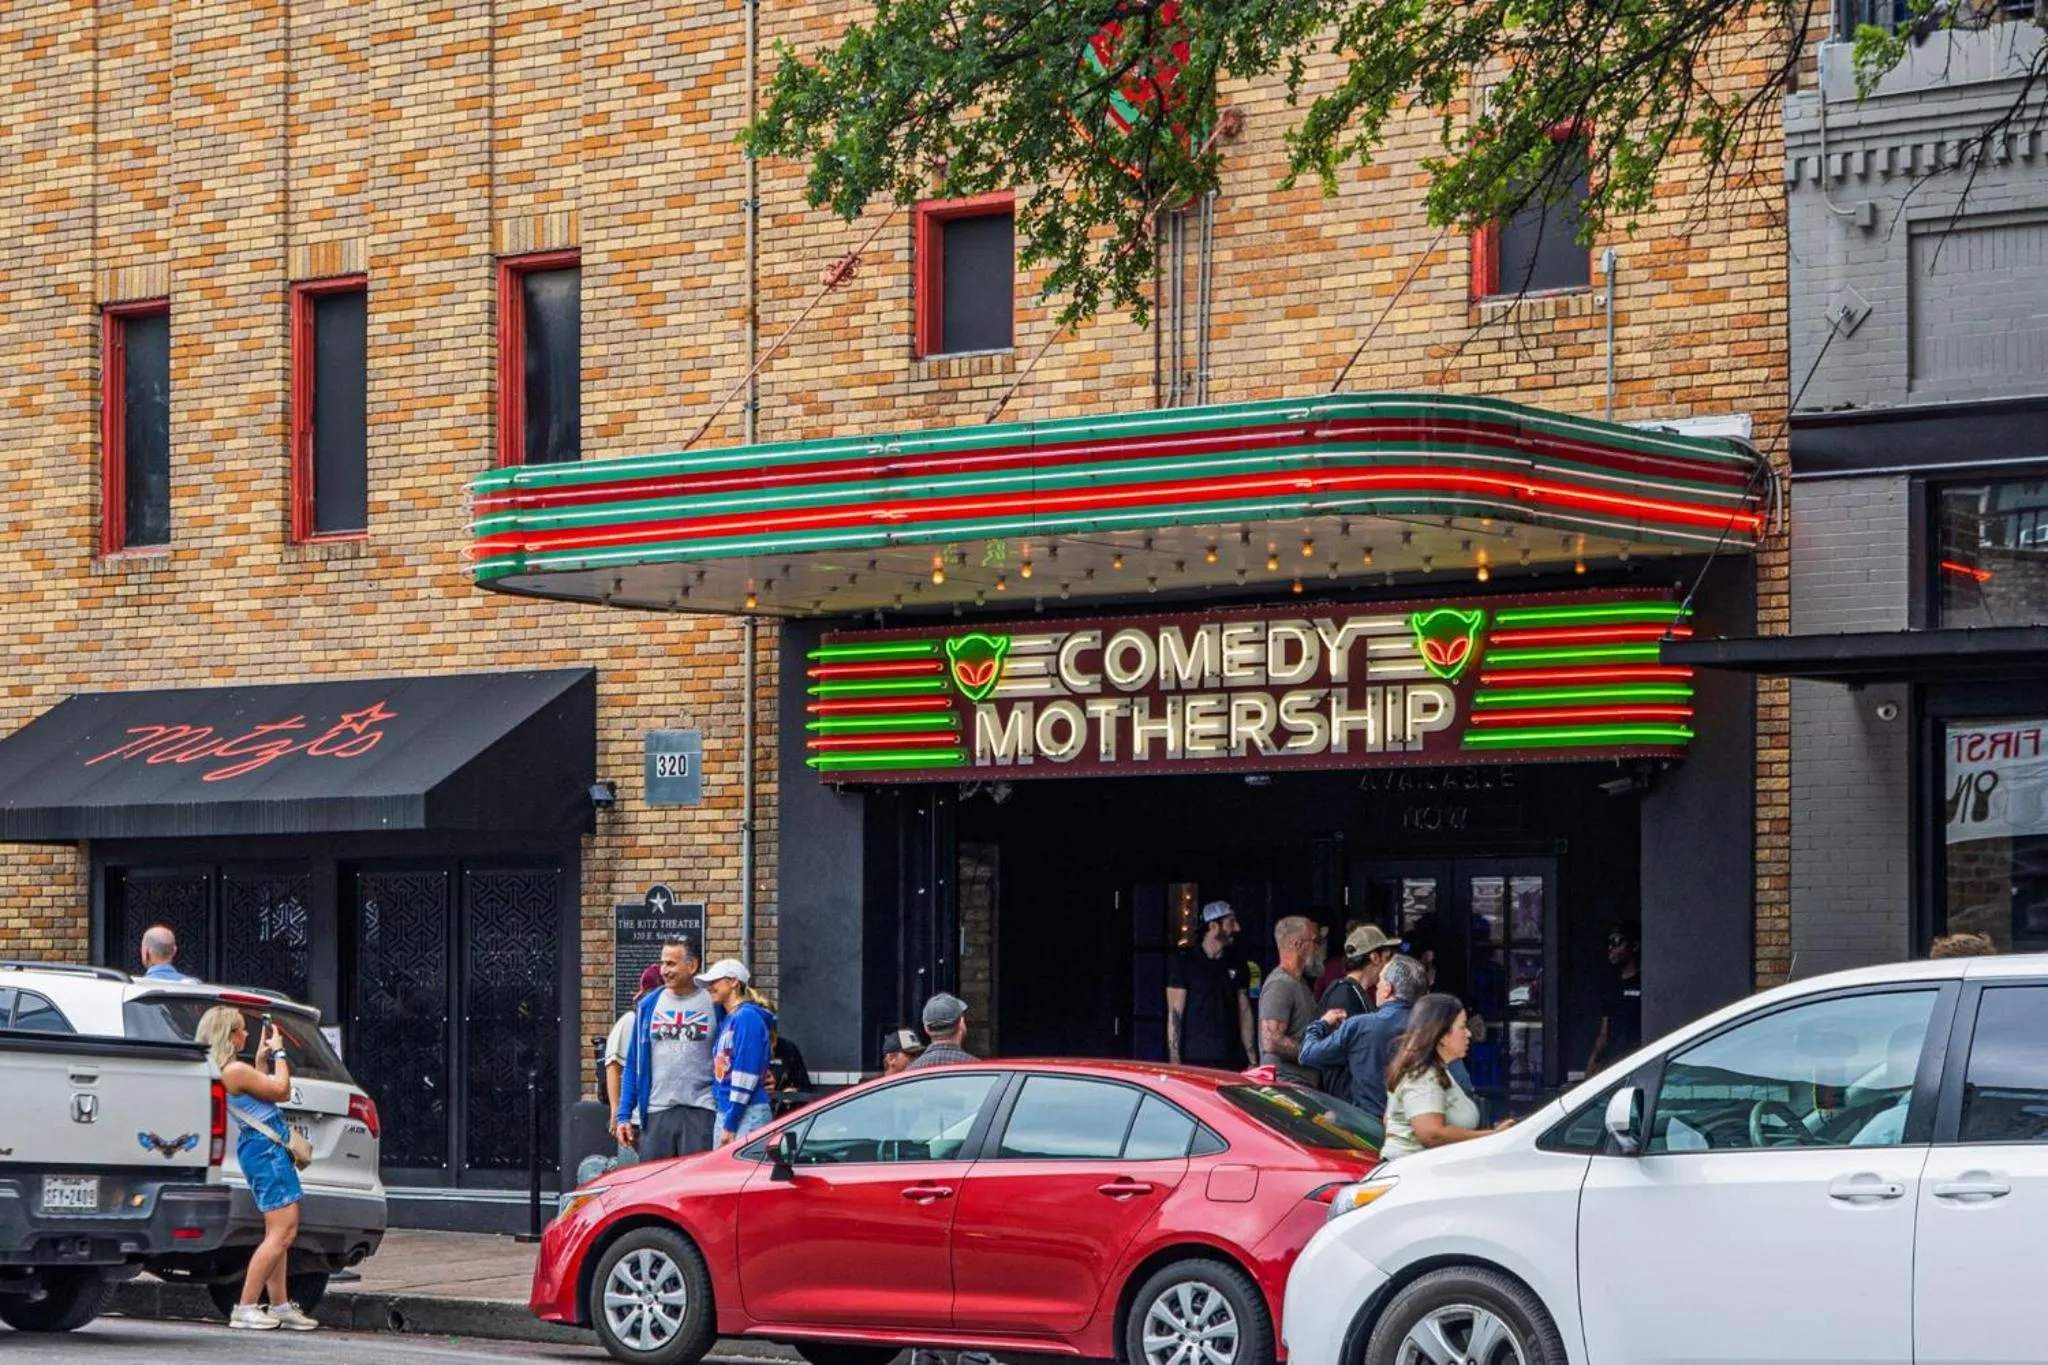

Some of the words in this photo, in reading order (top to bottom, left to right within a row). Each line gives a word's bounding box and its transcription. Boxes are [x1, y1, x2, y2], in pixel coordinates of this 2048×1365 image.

[1058, 618, 1350, 695] COMEDY
[975, 683, 1456, 767] MOTHERSHIP
[658, 755, 687, 776] 320
[618, 919, 635, 929] THE
[637, 919, 658, 929] RITZ
[660, 919, 701, 929] THEATER
